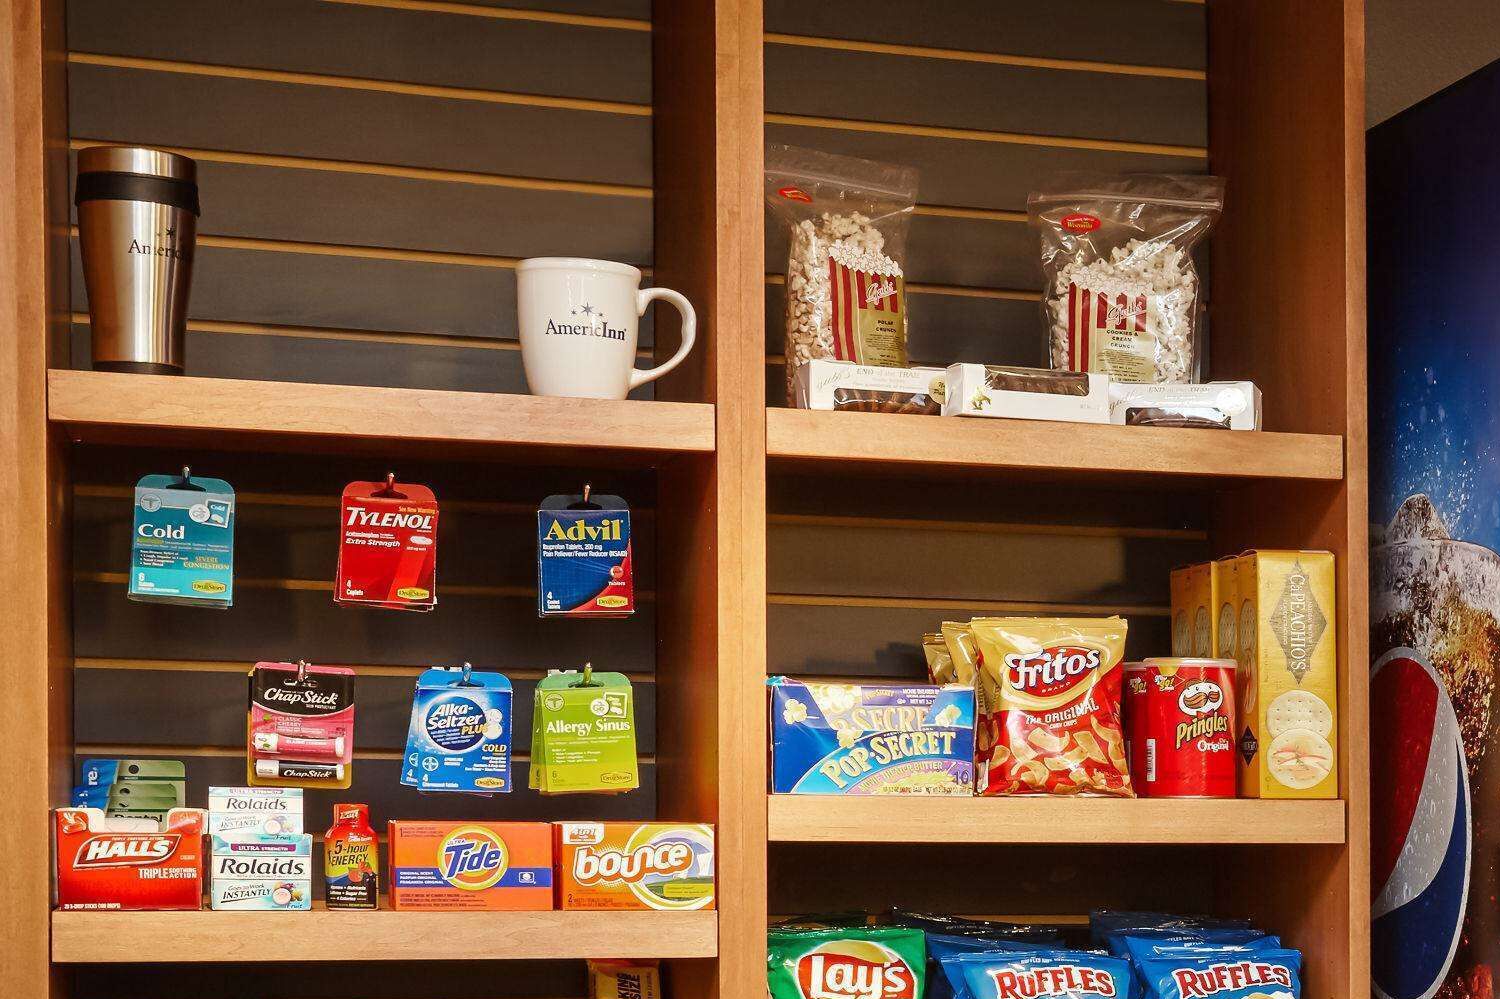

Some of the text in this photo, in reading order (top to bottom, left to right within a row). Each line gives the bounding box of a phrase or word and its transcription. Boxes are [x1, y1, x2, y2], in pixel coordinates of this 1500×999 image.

[545, 318, 625, 341] AmericInn
[138, 524, 185, 539] Cold
[543, 519, 622, 541] Advil
[1003, 647, 1101, 690] Fritos
[264, 687, 338, 705] ChapStick
[852, 706, 929, 732] SECRE
[1044, 698, 1100, 723] ORIGINAL
[427, 714, 485, 731] Seltzer
[546, 720, 631, 737] Allergy Sinus
[1176, 711, 1228, 750] Pringles
[284, 768, 332, 778] ChapStick
[226, 797, 287, 811] Rolaids
[86, 840, 170, 861] HALLS
[445, 842, 502, 878] Tide
[138, 868, 168, 879] TRIPLE
[220, 858, 305, 875] Rolaids
[575, 843, 690, 883] bounce
[222, 888, 272, 900] INSTANTLY
[617, 972, 629, 999] KING
